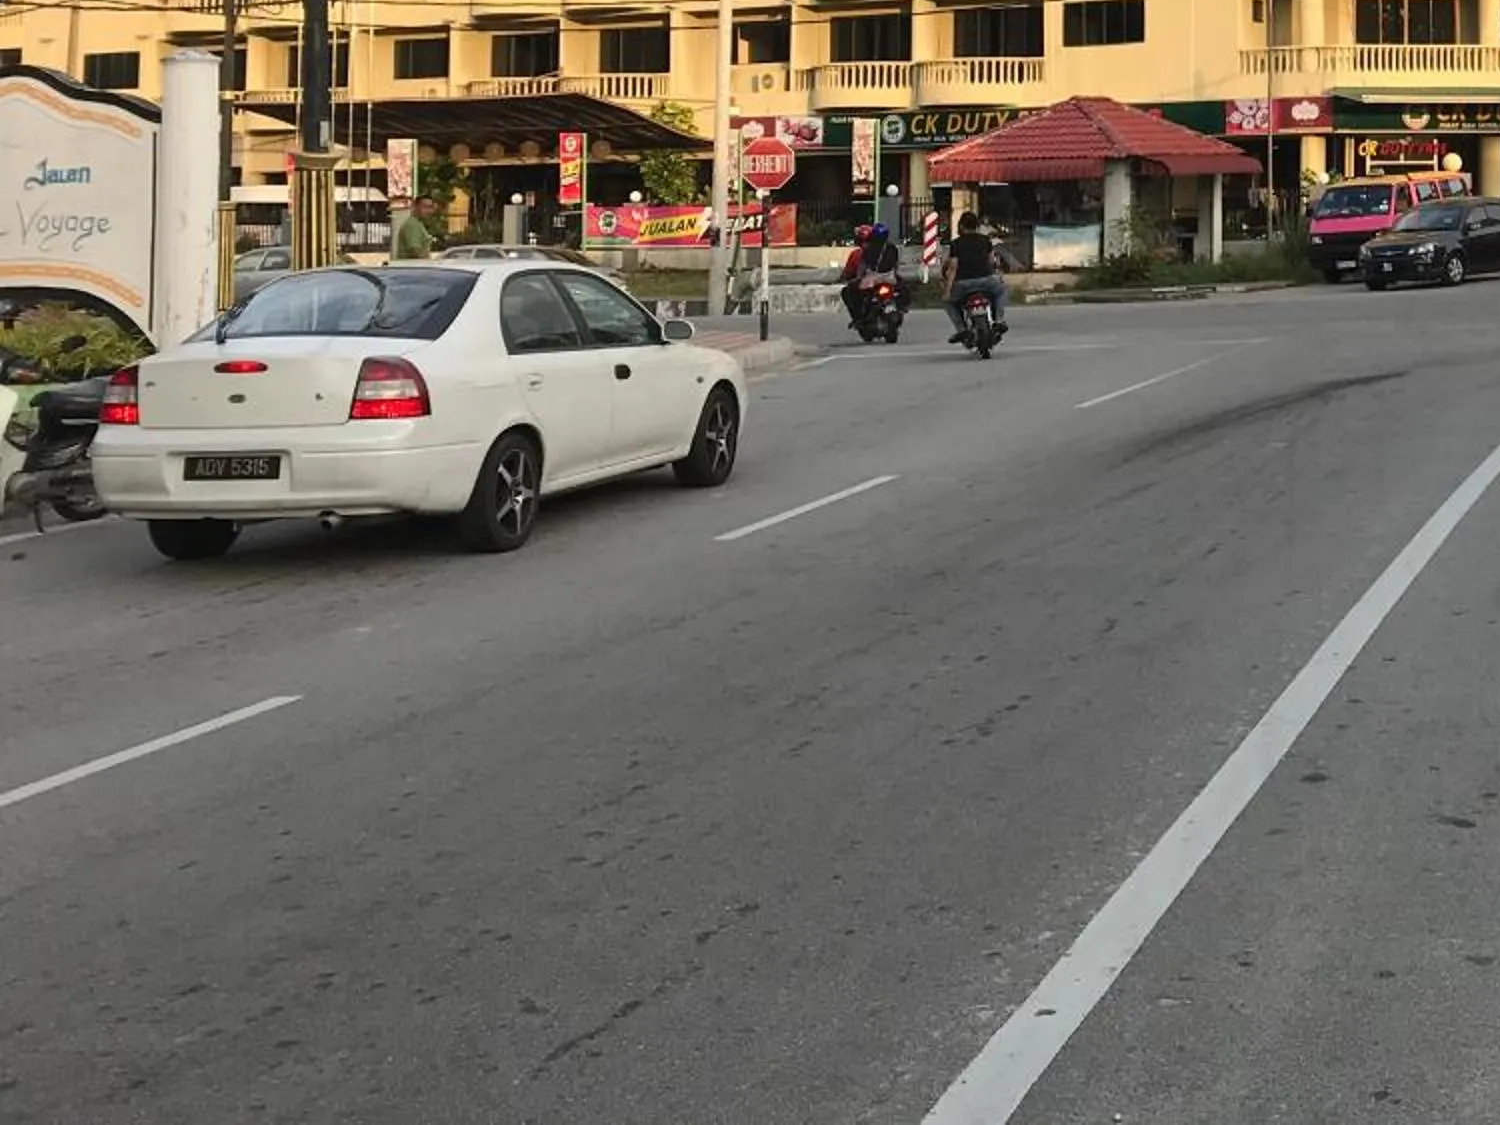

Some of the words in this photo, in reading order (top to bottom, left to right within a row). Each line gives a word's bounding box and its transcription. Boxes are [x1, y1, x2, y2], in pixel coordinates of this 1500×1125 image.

[910, 113, 940, 135] CK
[946, 111, 1009, 134] DUTY
[15, 199, 113, 252] Voyage
[640, 218, 698, 236] JUALAN
[231, 458, 271, 476] 5315
